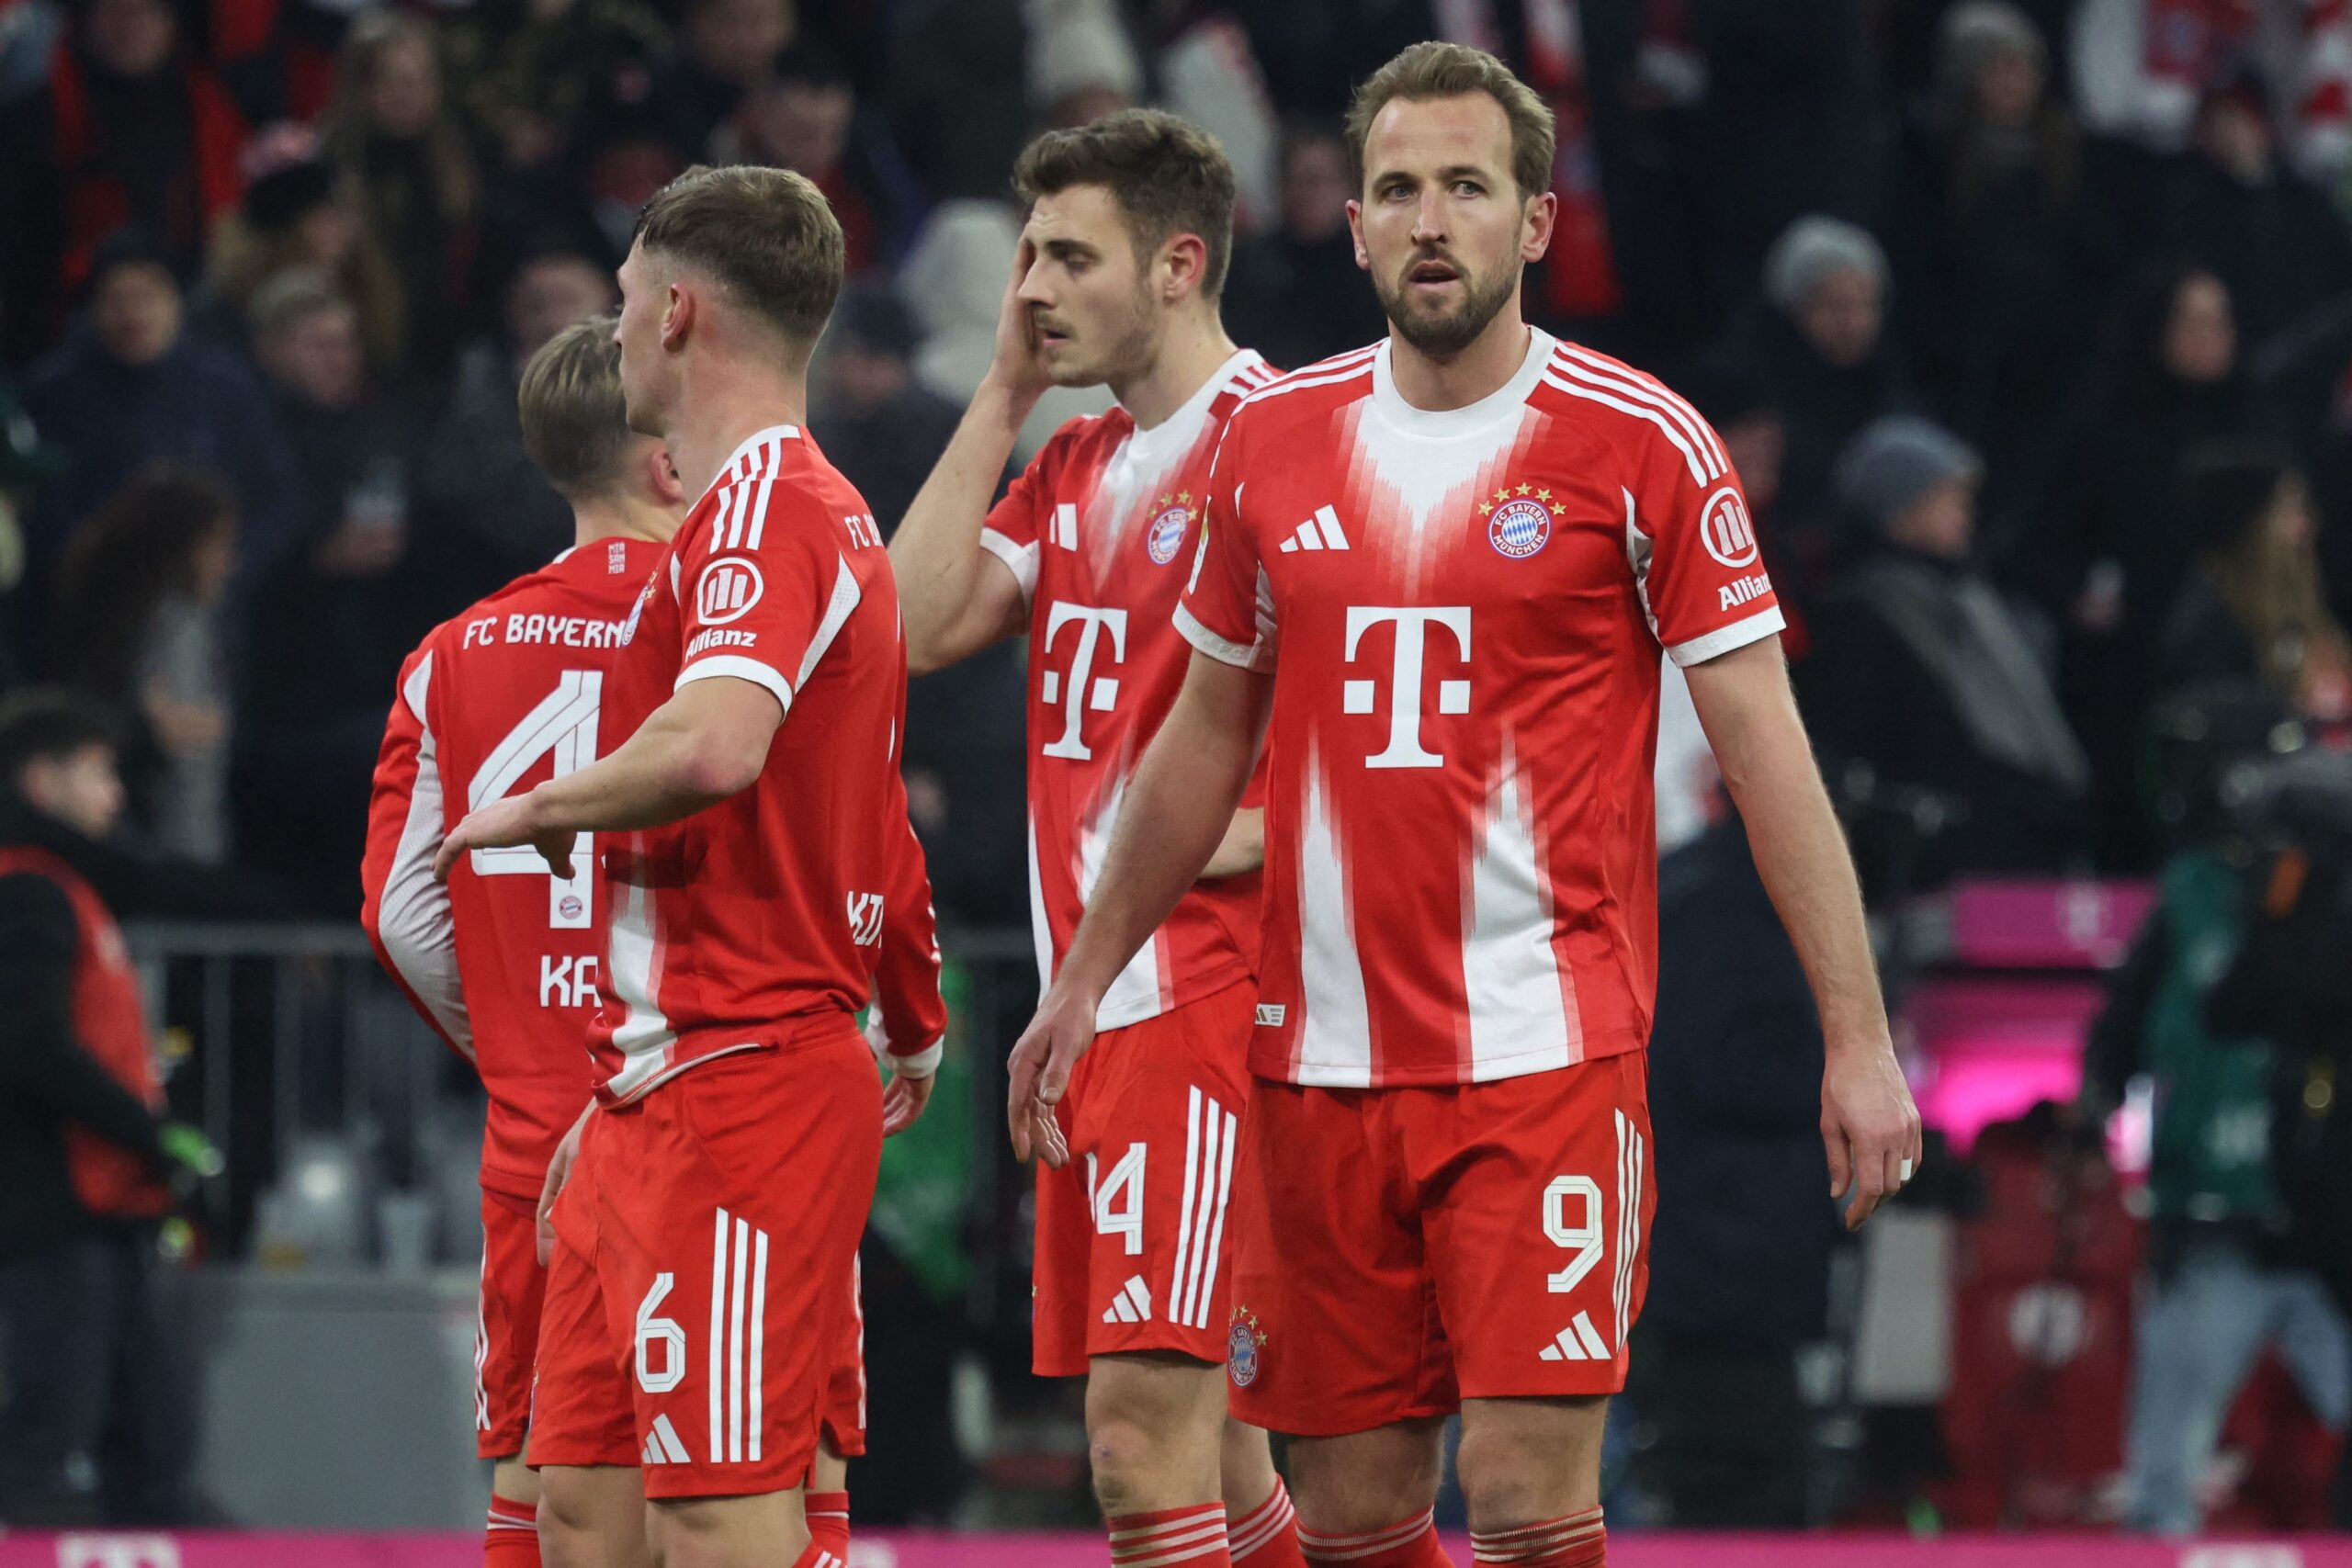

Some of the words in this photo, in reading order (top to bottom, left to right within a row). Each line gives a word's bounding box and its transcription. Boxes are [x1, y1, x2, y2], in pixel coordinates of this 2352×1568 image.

[843, 514, 870, 550] FC
[1494, 512, 1507, 526] FC
[1508, 503, 1545, 525] BAYERN
[463, 616, 497, 649] FC
[505, 614, 627, 649] BAYERN
[684, 627, 757, 663] Allianz
[1042, 601, 1128, 761] T
[1344, 605, 1472, 770] T
[469, 670, 606, 929] 4
[539, 955, 603, 1008] KA
[1543, 1175, 1604, 1293] 9
[634, 1272, 685, 1393] 6
